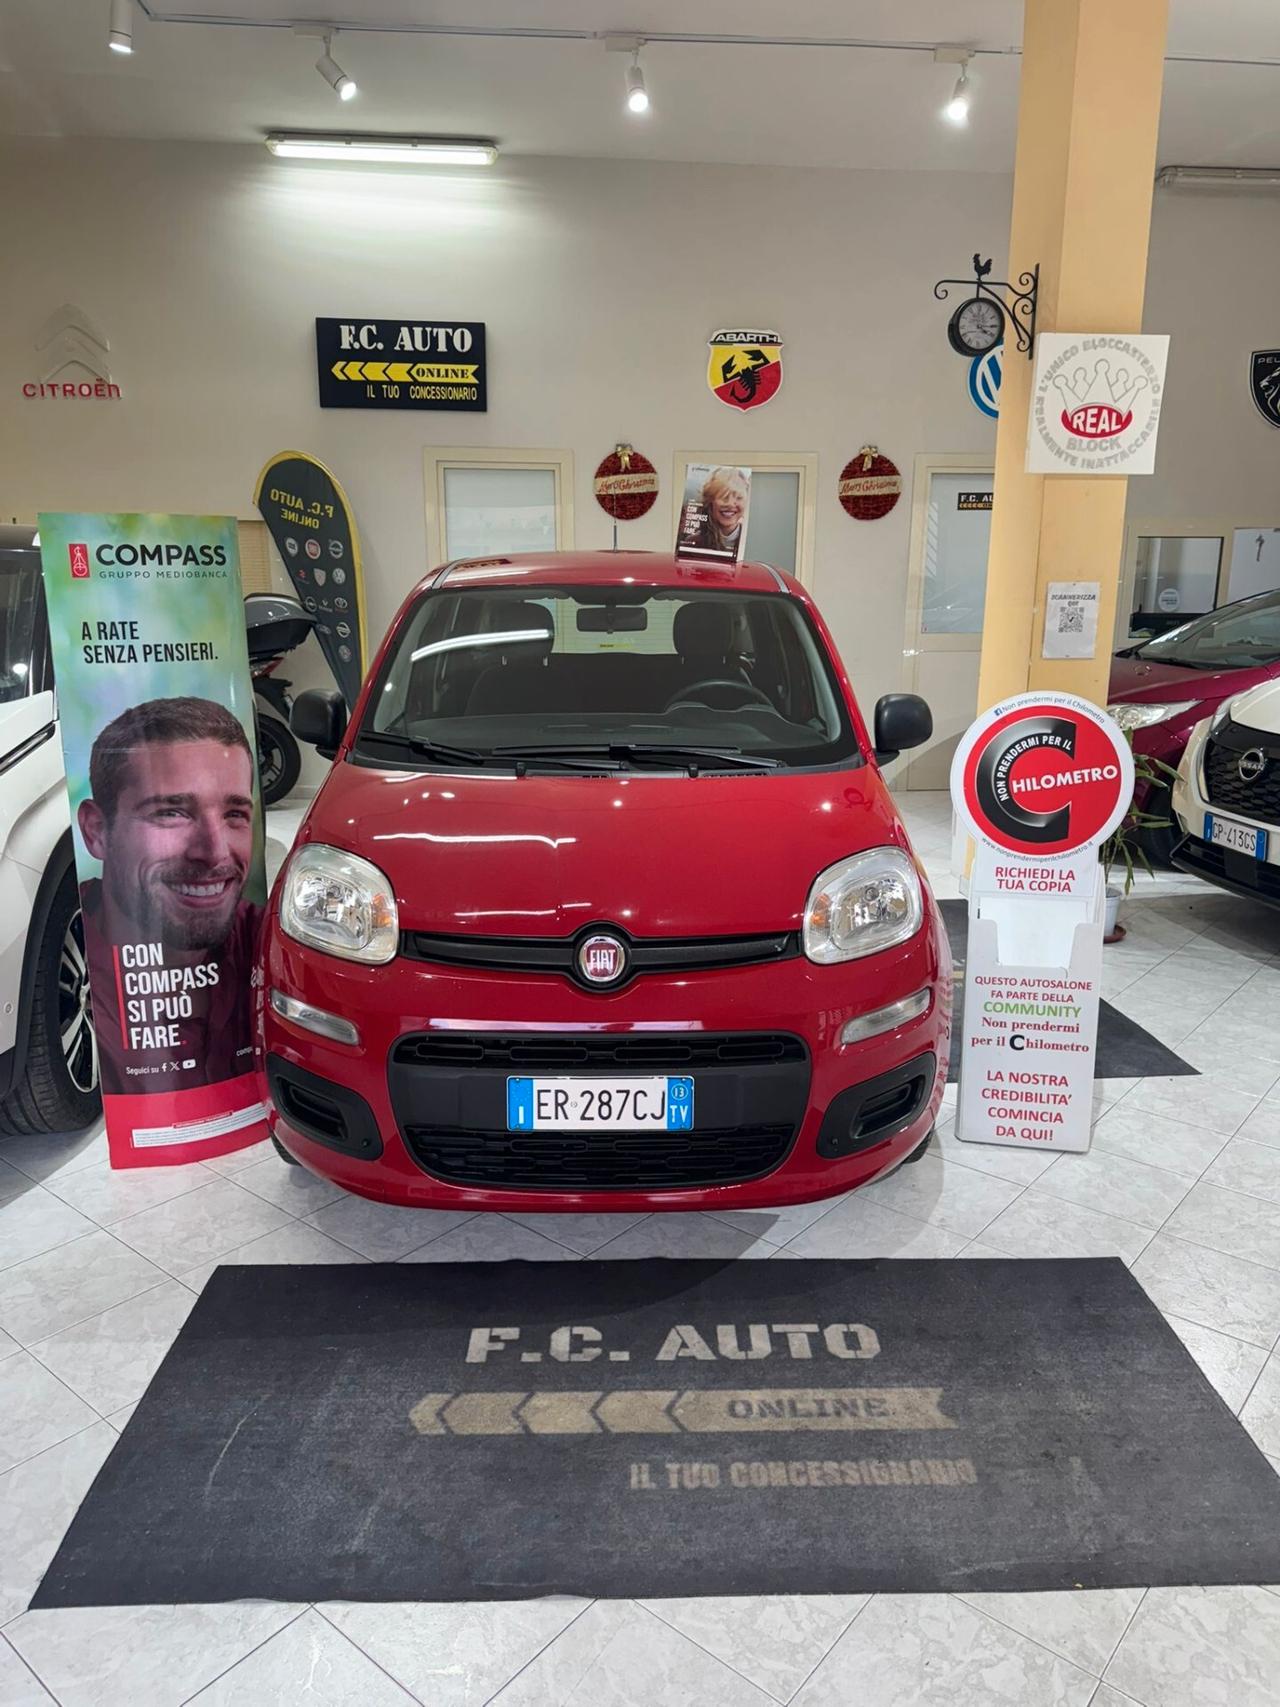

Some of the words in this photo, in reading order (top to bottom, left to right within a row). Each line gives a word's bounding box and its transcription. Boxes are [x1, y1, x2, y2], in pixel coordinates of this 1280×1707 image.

[340, 325, 385, 350] F.C.
[394, 327, 473, 352] AUTO
[715, 333, 778, 343] ABARTH
[416, 367, 470, 379] ONLINE
[367, 385, 376, 399] IL
[382, 385, 401, 399] TUO
[409, 386, 478, 401] CONCESSIONARIO
[1073, 408, 1122, 434] REAL
[1066, 437, 1122, 452] BLOCK
[96, 544, 227, 567] COMPASS
[100, 571, 151, 579] GRUPPO
[157, 570, 228, 579] MEDIOBANCA
[82, 621, 92, 641] A
[97, 621, 140, 641] RATE
[83, 645, 138, 664] SENZA
[143, 642, 219, 663] PENSIERI.
[1042, 735, 1061, 747] PER
[1063, 739, 1073, 751] IL
[997, 735, 1039, 779] PRENDERMI
[1012, 764, 1118, 794] HILOMETRO
[997, 783, 1009, 801] NON
[996, 866, 1055, 880] RICHIEDI
[1058, 869, 1075, 881] LA
[998, 879, 1025, 891] TUA
[1029, 880, 1072, 893] COPIA
[122, 943, 164, 968] CON
[589, 950, 616, 970] FIAT
[125, 962, 220, 996] COMPASS
[975, 976, 1018, 988] QUESTO
[1020, 979, 1092, 991] AUTOSALONE
[991, 989, 1004, 999] FA
[1006, 991, 1039, 1001] PARTE
[1042, 993, 1075, 1003] DELLA
[127, 999, 147, 1023] SI
[152, 989, 194, 1021] PUÒ
[983, 1001, 1082, 1018] COMMUNITY
[982, 1017, 1007, 1028] Non
[1012, 1020, 1081, 1034] prendermi
[971, 1037, 993, 1047] per
[996, 1036, 1006, 1047] il
[1009, 1034, 1090, 1053] Chilometro
[126, 1065, 150, 1076] Seguici
[987, 1070, 1004, 1082] LA
[1008, 1071, 1069, 1087] NOSTRA
[981, 1088, 1072, 1105] CREDIBILITA'
[537, 1090, 570, 1121] ER
[579, 1090, 665, 1121] 287CJ
[669, 1105, 688, 1123] TV
[987, 1106, 1064, 1123] COMINCIA
[995, 1125, 1017, 1138] DA
[1020, 1127, 1054, 1141] QUI!
[466, 1326, 630, 1363] F.C.
[656, 1323, 880, 1361] AUTO
[727, 1397, 890, 1421] ONLINE
[630, 1462, 657, 1489] IL
[665, 1461, 721, 1489] TUO
[728, 1458, 978, 1488] CONCESSIONARIO
